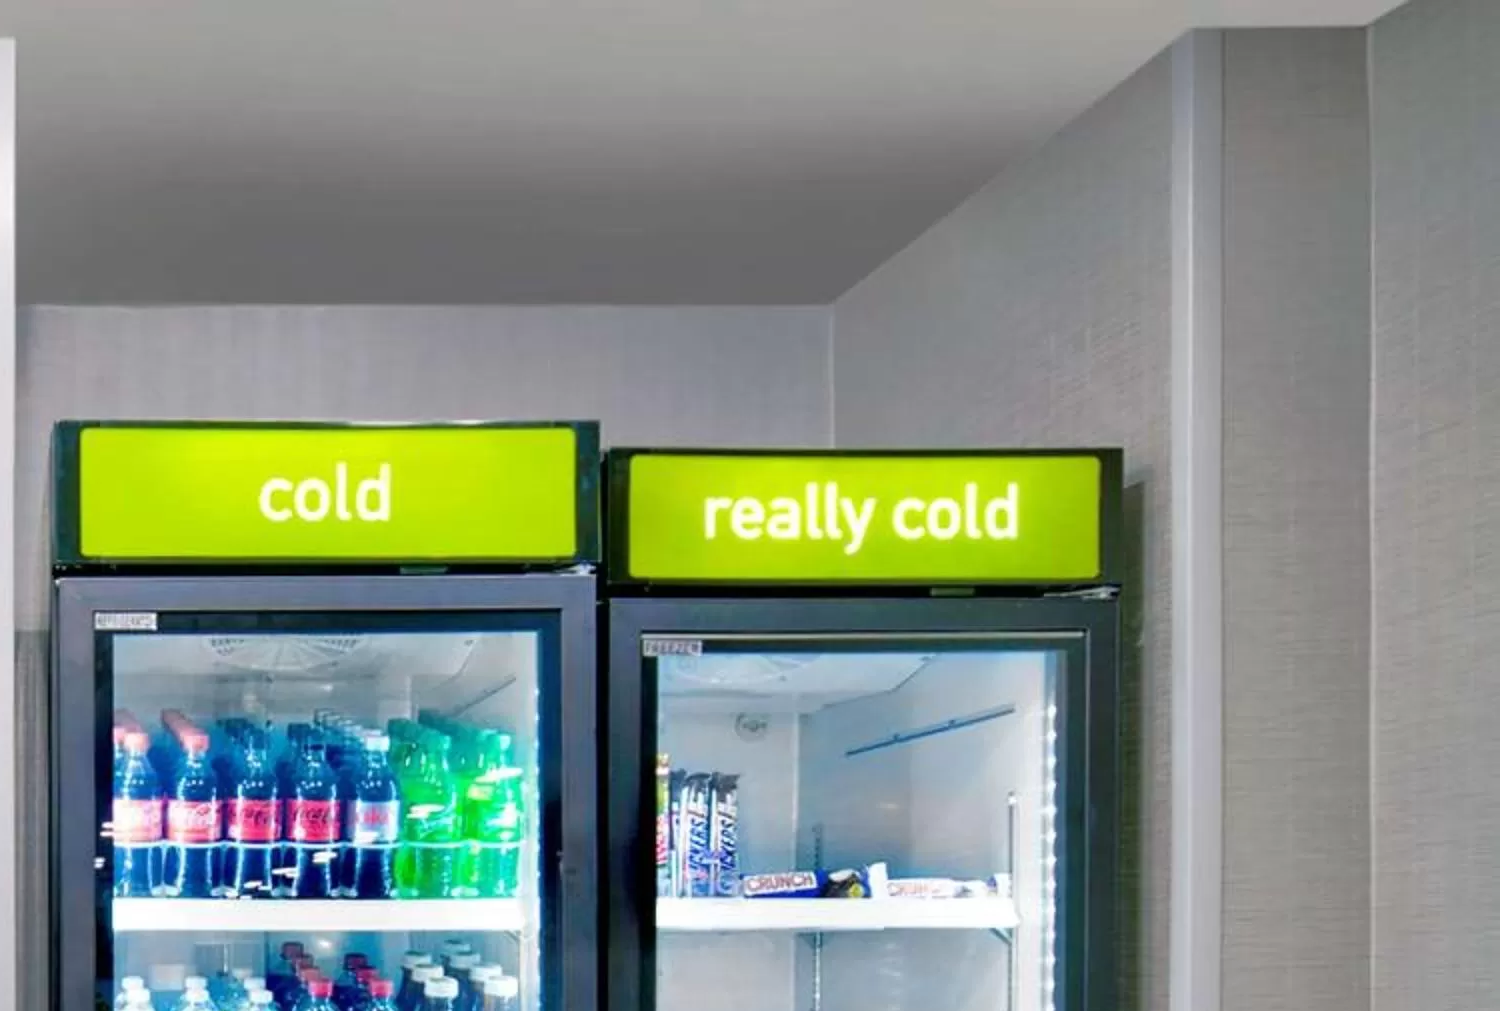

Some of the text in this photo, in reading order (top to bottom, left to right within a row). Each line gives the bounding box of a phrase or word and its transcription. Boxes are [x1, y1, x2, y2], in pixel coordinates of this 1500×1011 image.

[259, 462, 392, 522] cold
[704, 481, 1019, 556] really cold
[746, 873, 813, 893] CRUNCH
